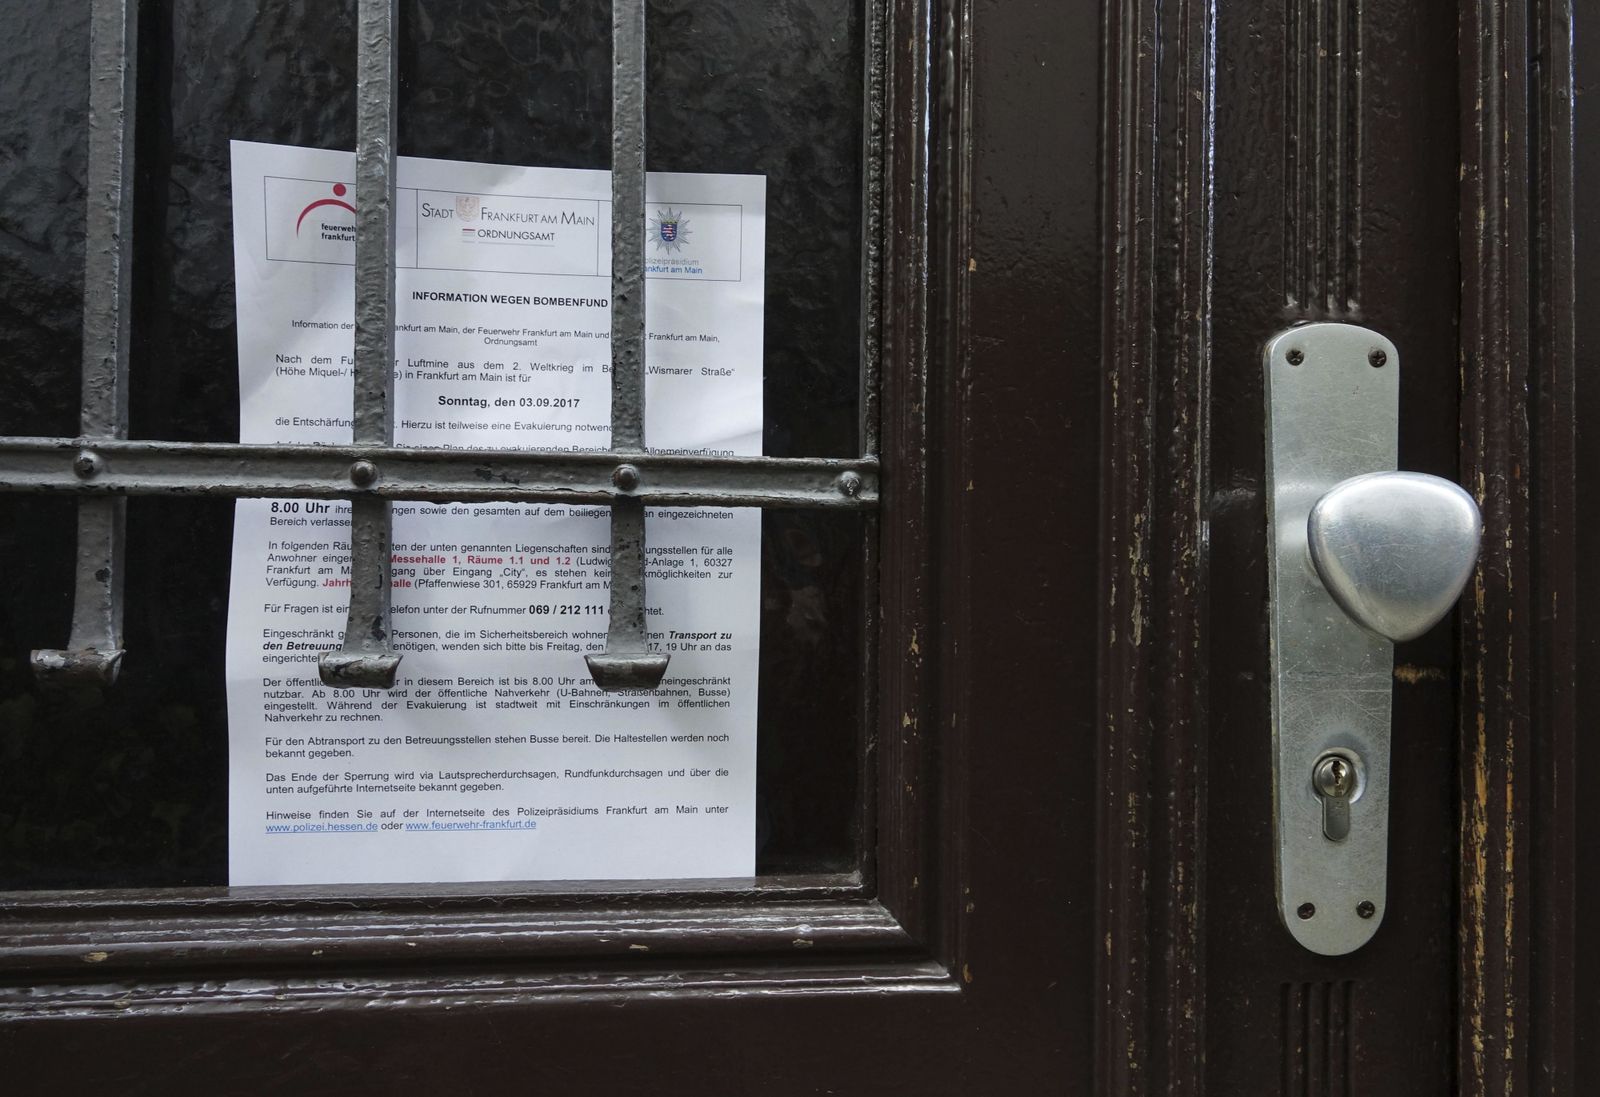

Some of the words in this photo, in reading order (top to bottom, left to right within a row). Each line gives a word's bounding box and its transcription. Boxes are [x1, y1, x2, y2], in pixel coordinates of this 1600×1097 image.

[481, 207, 538, 223] FRANKFURT
[540, 215, 558, 224] AM
[560, 212, 594, 226] MAIN
[321, 223, 356, 232] feuerweh
[321, 233, 356, 241] frankfurt
[477, 229, 555, 240] ORDNUNGSAMT
[685, 266, 703, 274] Main
[412, 291, 487, 303] INFORMATION
[491, 295, 530, 305] WEGEN
[533, 297, 608, 307] BOMBENFUND
[292, 320, 339, 329] Information
[439, 325, 460, 334] Main,
[478, 327, 520, 336] Feuerwehr
[522, 329, 557, 337] Frankfurt
[574, 330, 592, 338] Main
[594, 331, 609, 339] und
[649, 333, 683, 341] Frankfurt
[700, 334, 720, 343] Main,
[484, 337, 538, 347] Ordnungsamt
[276, 355, 302, 364] Nach
[408, 358, 449, 368] Luftmine
[513, 362, 522, 370] 2.
[530, 362, 574, 374] Weltkrieg
[275, 366, 307, 377] (Höhe
[416, 370, 459, 380] Frankfurt
[480, 372, 503, 382] Main
[438, 396, 490, 408] Sonntag,
[519, 398, 580, 408] 03.09.2017
[402, 420, 432, 429] Hierzu
[434, 421, 446, 429] ist
[448, 421, 489, 430] teilweise
[491, 422, 511, 430] eine
[514, 422, 572, 433] Evakuierung
[271, 502, 299, 512] 8.00
[305, 503, 330, 513] Uhr
[420, 506, 447, 514] sowie
[473, 507, 521, 517] gesamten
[658, 509, 733, 520] eingezeichneten
[270, 517, 309, 526] Bereich
[268, 542, 277, 550] In
[281, 542, 329, 552] folgenden
[430, 543, 457, 552] unten
[461, 543, 512, 554] genannten
[515, 544, 588, 555] Liegenschaften
[591, 545, 611, 553] sind
[717, 547, 732, 555] alle
[267, 554, 316, 563] Anwohner
[389, 555, 445, 564] Messehalle
[452, 556, 461, 565] 1,
[467, 556, 503, 564] Räume
[509, 556, 524, 564] 1.1
[556, 557, 571, 565] 1.2
[691, 558, 698, 568] 1,
[704, 558, 732, 567] 60327
[267, 566, 310, 575] Frankfurt
[424, 567, 445, 575] über
[453, 567, 492, 578] Eingang
[555, 569, 587, 577] stehen
[266, 578, 319, 588] Verfügung.
[414, 580, 480, 590] (Pfaffenwiese
[483, 580, 504, 589] 301,
[507, 580, 537, 588] 65929
[540, 581, 583, 589] Frankfurt
[264, 605, 281, 613] Für
[284, 605, 319, 615] Fragen
[423, 605, 448, 614] unter
[451, 606, 467, 614] der
[470, 606, 527, 614] Rufnummer
[529, 605, 550, 614] 069
[560, 605, 581, 615] 212
[585, 605, 603, 615] 111
[263, 630, 334, 640] Eingeschränkt
[391, 630, 441, 640] Personen,
[480, 630, 568, 639] Sicherheitsbereich
[669, 631, 717, 641] Transport
[441, 642, 480, 650] wenden
[483, 642, 502, 650] sich
[506, 642, 527, 651] bitte
[546, 643, 583, 652] Freitag,
[666, 643, 677, 651] 19
[680, 643, 697, 651] Uhr
[263, 679, 281, 687] Der
[417, 677, 453, 686] diesem
[458, 677, 494, 686] Bereich
[514, 677, 528, 685] bis
[532, 677, 553, 685] 8.00
[558, 677, 575, 685] Uhr
[264, 690, 303, 698] nutzbar.
[312, 690, 326, 698] Ab
[333, 690, 355, 698] 8.00
[363, 689, 380, 698] Uhr
[387, 689, 408, 698] wird
[438, 689, 487, 697] öffentliche
[495, 689, 550, 697] Nahverkehr
[557, 689, 611, 699] (U-Bahnen,
[698, 689, 730, 698] Busse)
[264, 702, 318, 712] eingestellt.
[328, 701, 372, 710] Während
[407, 701, 467, 711] Evakuierung
[495, 701, 538, 709] stadtweit
[570, 700, 650, 710] Einschränkungen
[677, 699, 730, 708] öffentlichen
[265, 713, 323, 722] Nahverkehr
[340, 713, 383, 721] rechnen.
[265, 737, 282, 746] Für
[307, 736, 365, 747] Abtransport
[405, 735, 491, 746] Betreuungsstellen
[494, 735, 526, 744] stehen
[530, 735, 559, 743] Busse
[562, 734, 591, 743] bereit.
[595, 734, 611, 743] Die
[614, 734, 667, 742] Haltestellen
[671, 734, 704, 742] werden
[707, 734, 729, 742] noch
[266, 749, 306, 758] bekannt
[308, 749, 354, 759] gegeben.
[266, 773, 286, 781] Das
[291, 773, 318, 781] Ende
[344, 772, 389, 782] Sperrung
[394, 772, 414, 780] wird
[439, 770, 559, 781] Lautsprecherdurchsagen,
[565, 769, 663, 780] Rundfunkdurchsagen
[668, 769, 685, 777] und
[690, 769, 710, 777] über
[266, 786, 294, 794] unten
[297, 784, 352, 795] aufgeführte
[356, 783, 416, 792] Internetseite
[419, 783, 457, 791] bekannt
[460, 782, 504, 793] gegeben.
[266, 811, 311, 820] Hinweise
[319, 811, 349, 819] finden
[357, 810, 373, 819] Sie
[426, 808, 485, 818] Internetseite
[517, 807, 599, 818] Polizeipräsidiums
[606, 806, 647, 814] Frankfurt
[676, 805, 698, 814] Main
[705, 805, 728, 814] unter
[265, 822, 378, 833] www.polizei.hessen.de
[381, 822, 403, 830] oder
[405, 820, 536, 831] www.feuerwehr-frankfurt.de
